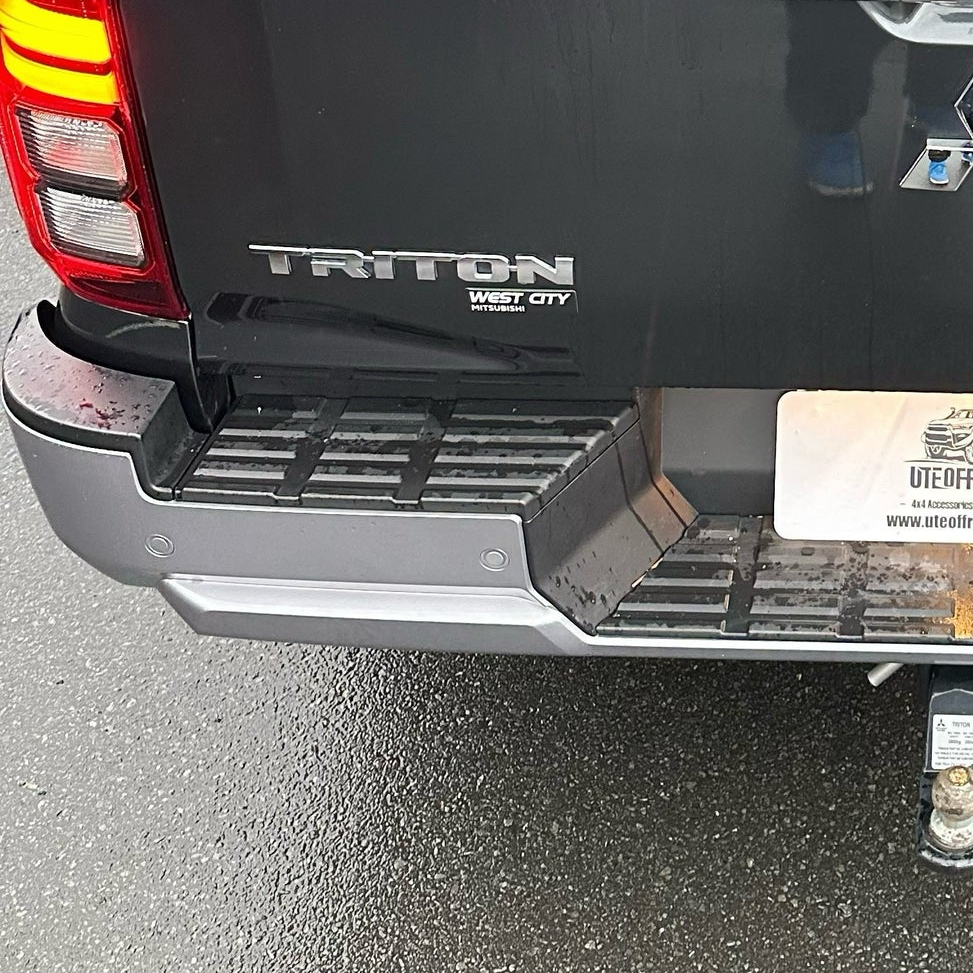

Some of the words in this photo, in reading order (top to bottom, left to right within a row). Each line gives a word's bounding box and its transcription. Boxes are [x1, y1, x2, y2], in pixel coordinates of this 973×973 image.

[248, 243, 575, 286] TRITON
[469, 290, 524, 305] WEST
[528, 291, 572, 306] CITY
[471, 304, 526, 313] MITSUBISHI
[911, 499, 926, 509] 4x4
[927, 499, 973, 510] Accessories
